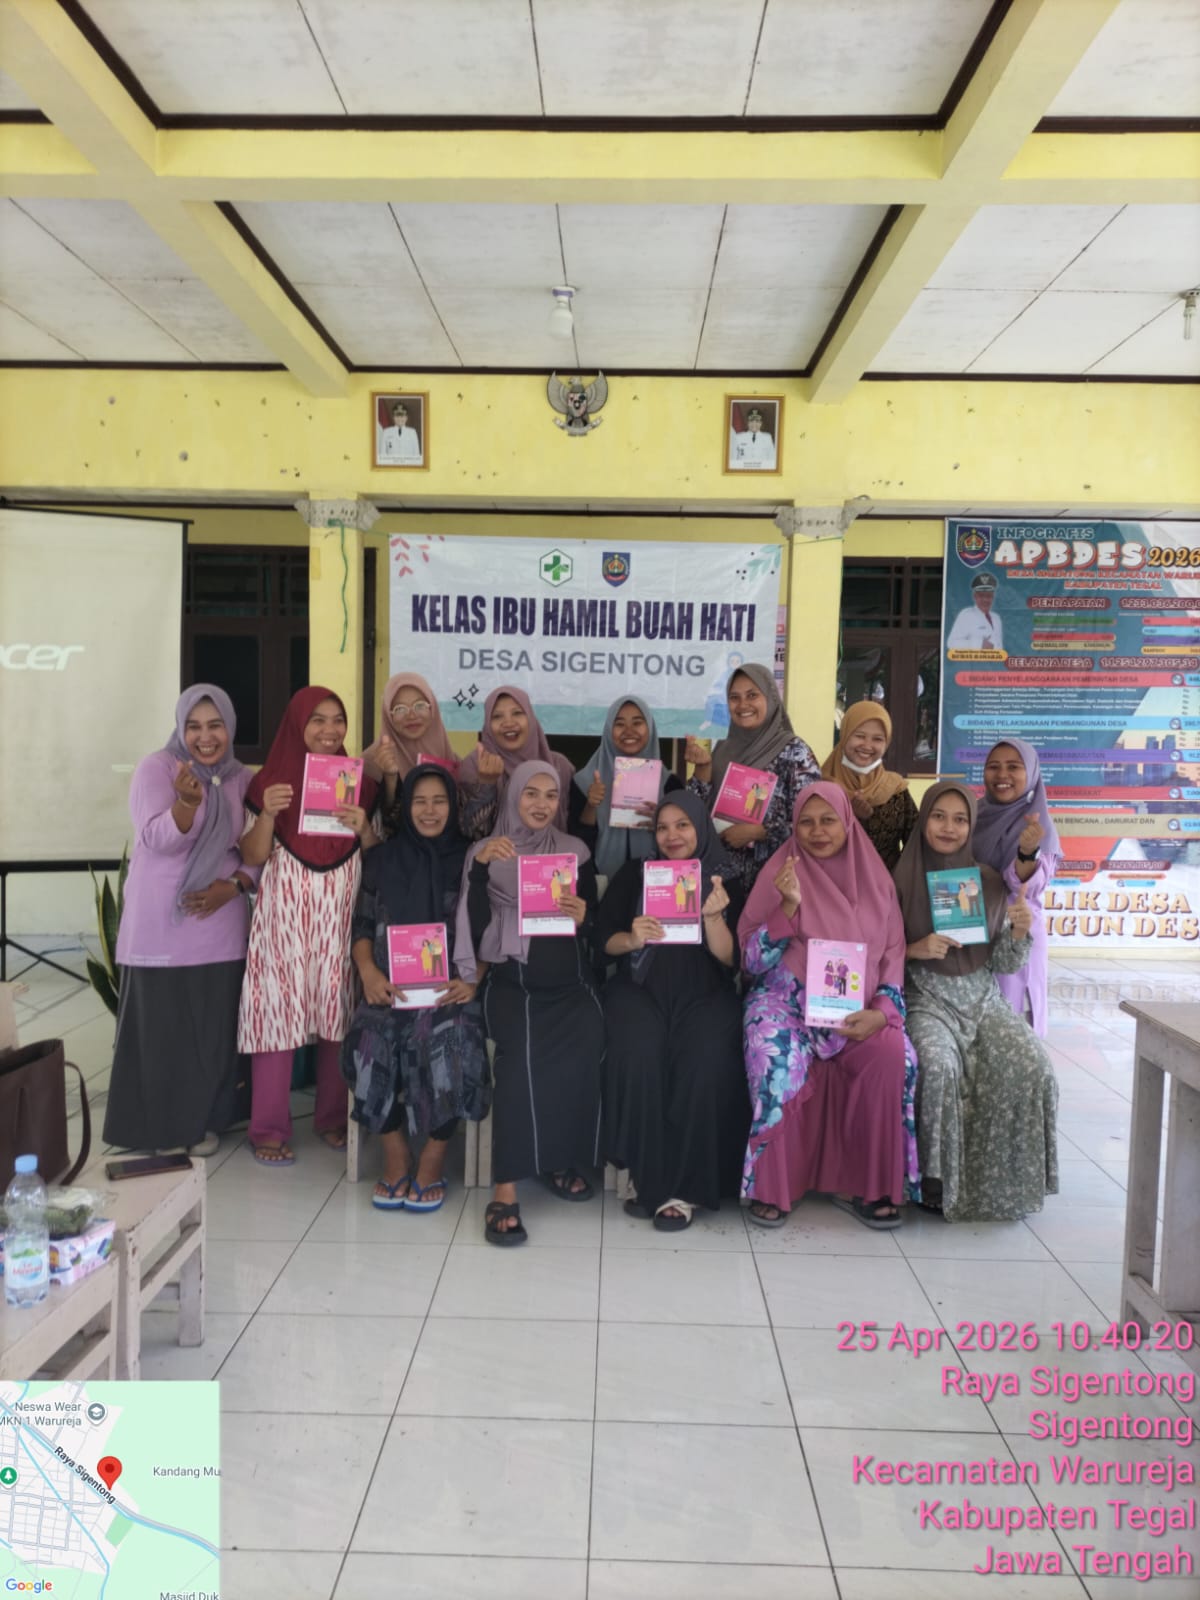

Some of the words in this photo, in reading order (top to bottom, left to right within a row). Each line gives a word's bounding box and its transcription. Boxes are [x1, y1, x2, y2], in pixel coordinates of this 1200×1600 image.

[997, 526, 1095, 540] INFOGRAFIS
[993, 540, 1147, 571] APBDES
[1148, 546, 1200, 568] 2026
[1031, 598, 1105, 609] PENDAPATAN
[411, 594, 486, 634] KELAS
[493, 595, 536, 636] IBU
[543, 597, 619, 638] HAMIL
[626, 600, 694, 640] BUAH
[700, 602, 757, 642] HATI
[0, 642, 86, 671] cer
[459, 648, 534, 672] DESA
[541, 650, 706, 677] SIGENTONG
[1044, 890, 1101, 911] LIK
[1106, 892, 1192, 915] DESA
[1132, 917, 1200, 940] DES
